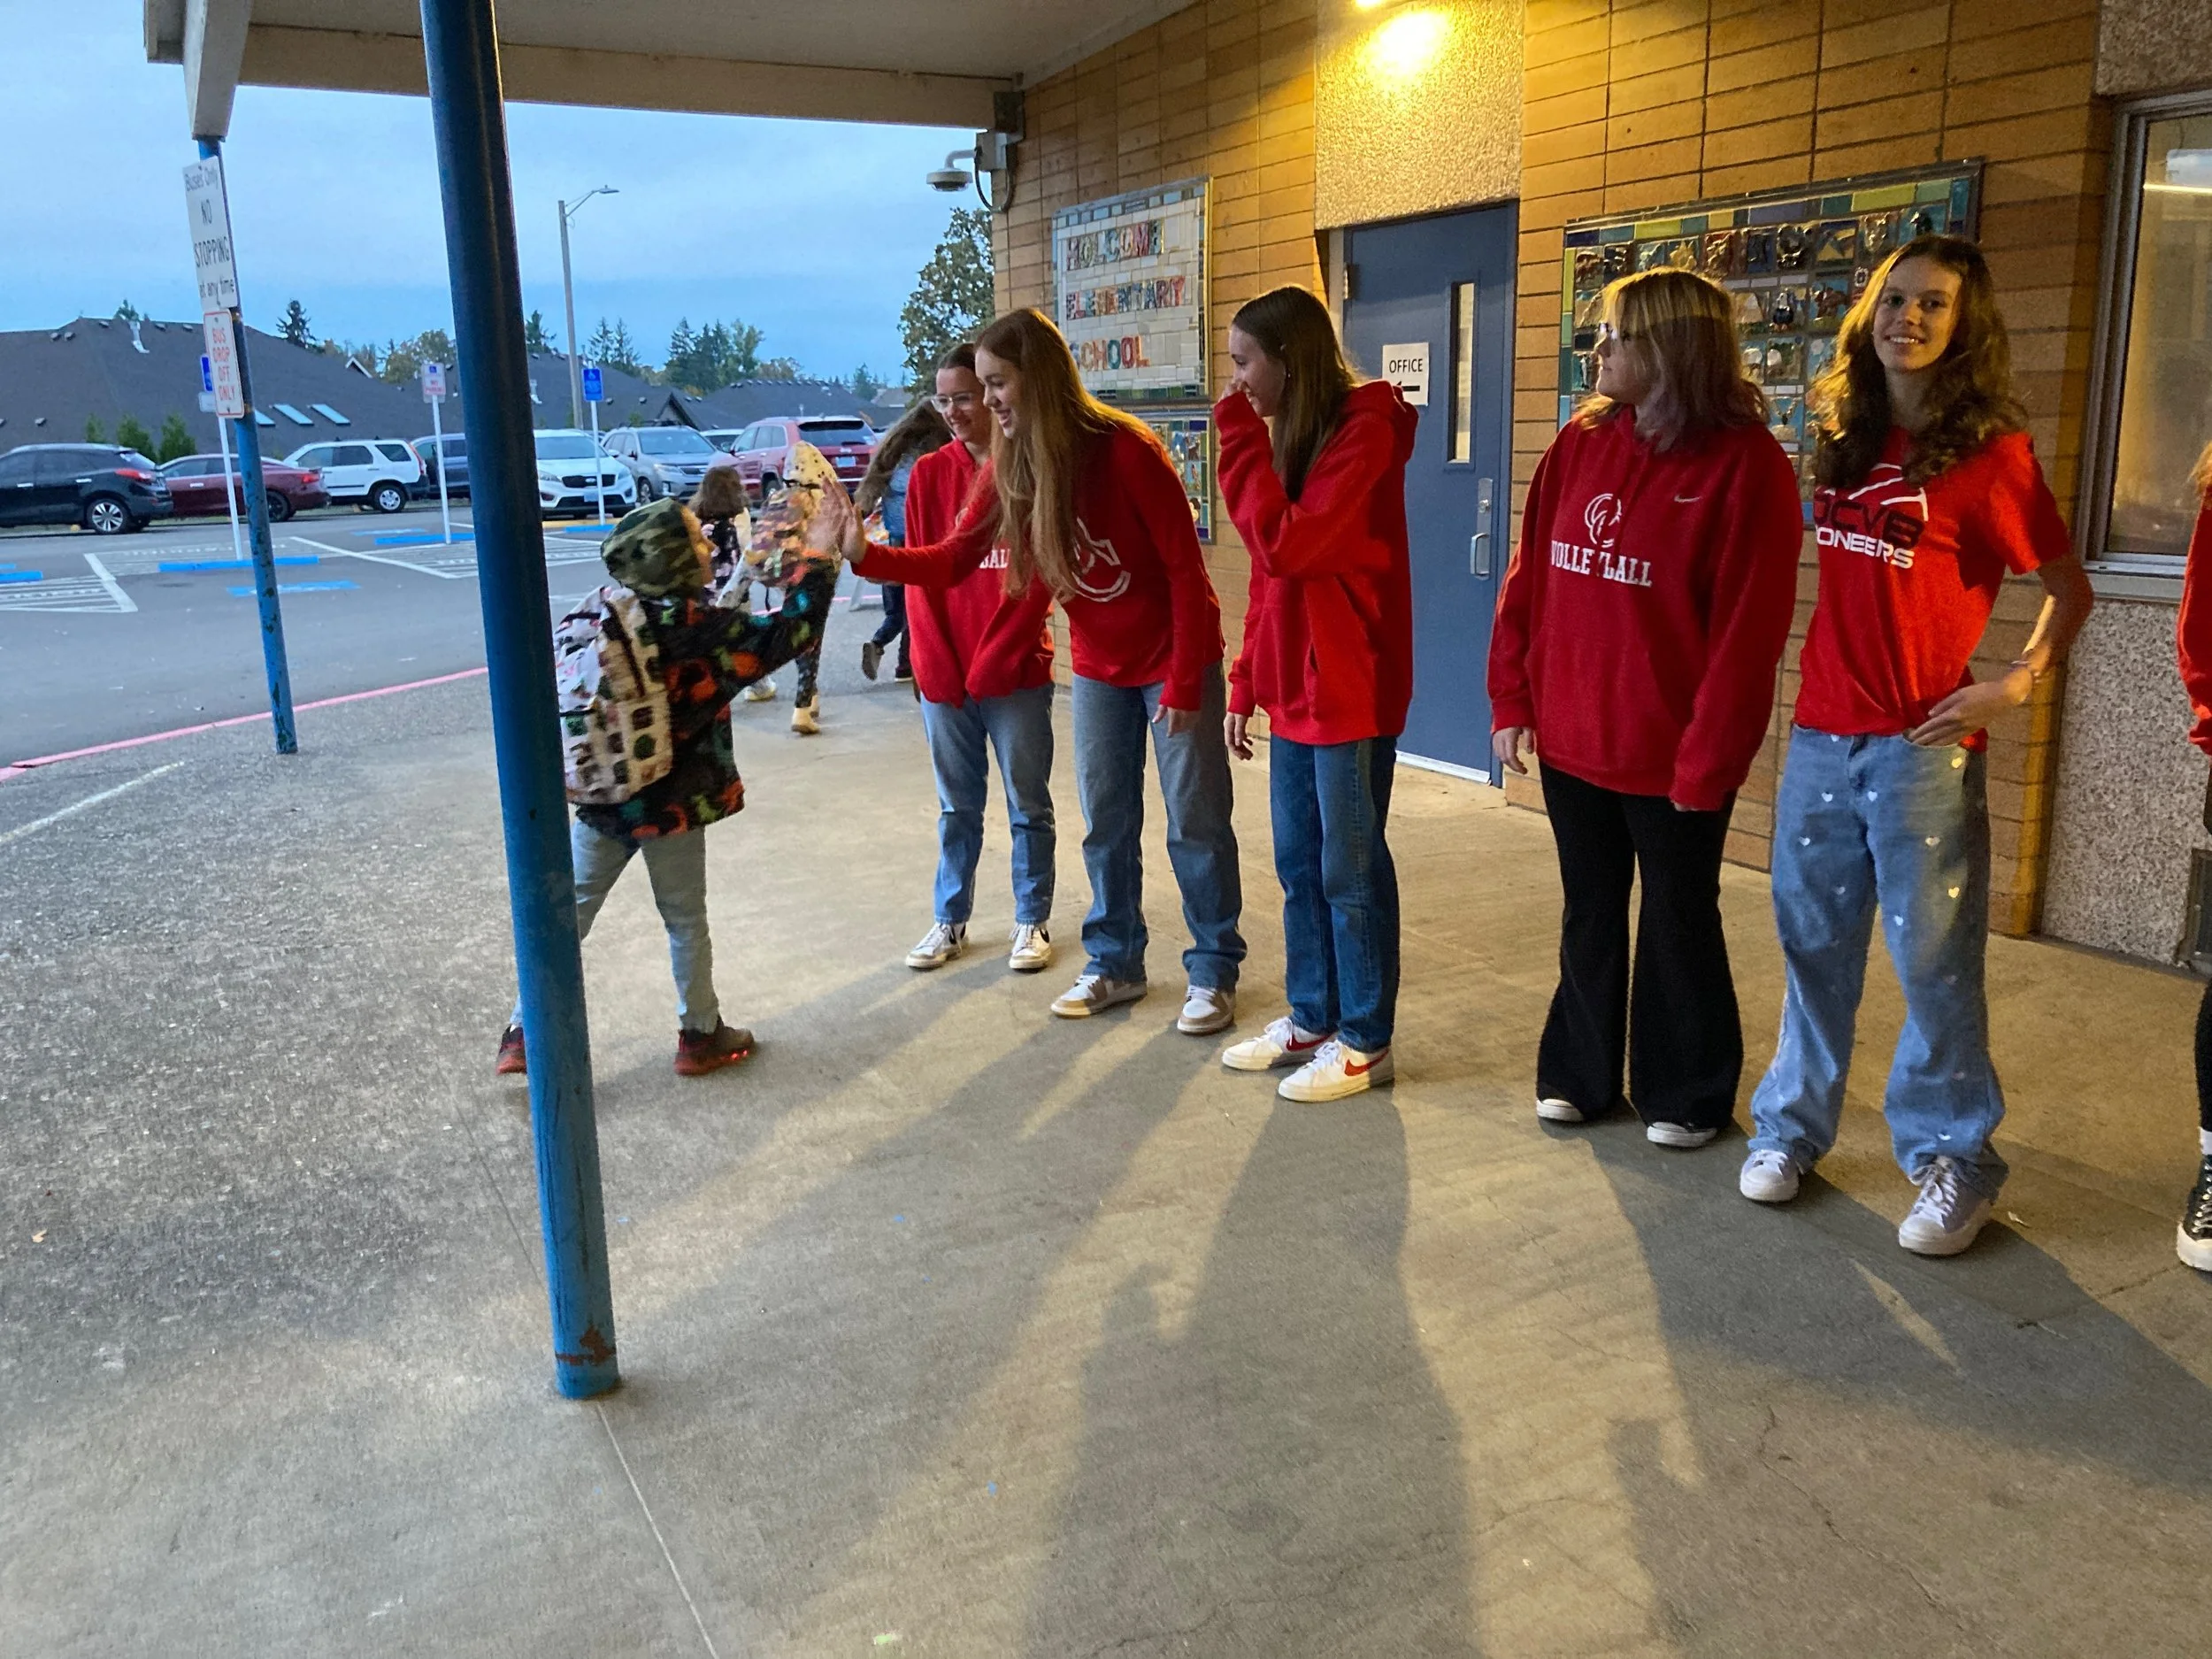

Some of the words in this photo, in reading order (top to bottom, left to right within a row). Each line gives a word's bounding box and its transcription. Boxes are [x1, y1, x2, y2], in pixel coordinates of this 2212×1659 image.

[201, 199, 212, 225] NO
[194, 236, 230, 267] STOPPING
[1067, 219, 1164, 271] HOLCOMB
[1066, 276, 1186, 320] ELEMENTARY
[219, 365, 229, 381] OFF
[1389, 358, 1423, 373] OFFICE
[219, 385, 234, 400] ONLY
[1816, 524, 1915, 569] ONEERS
